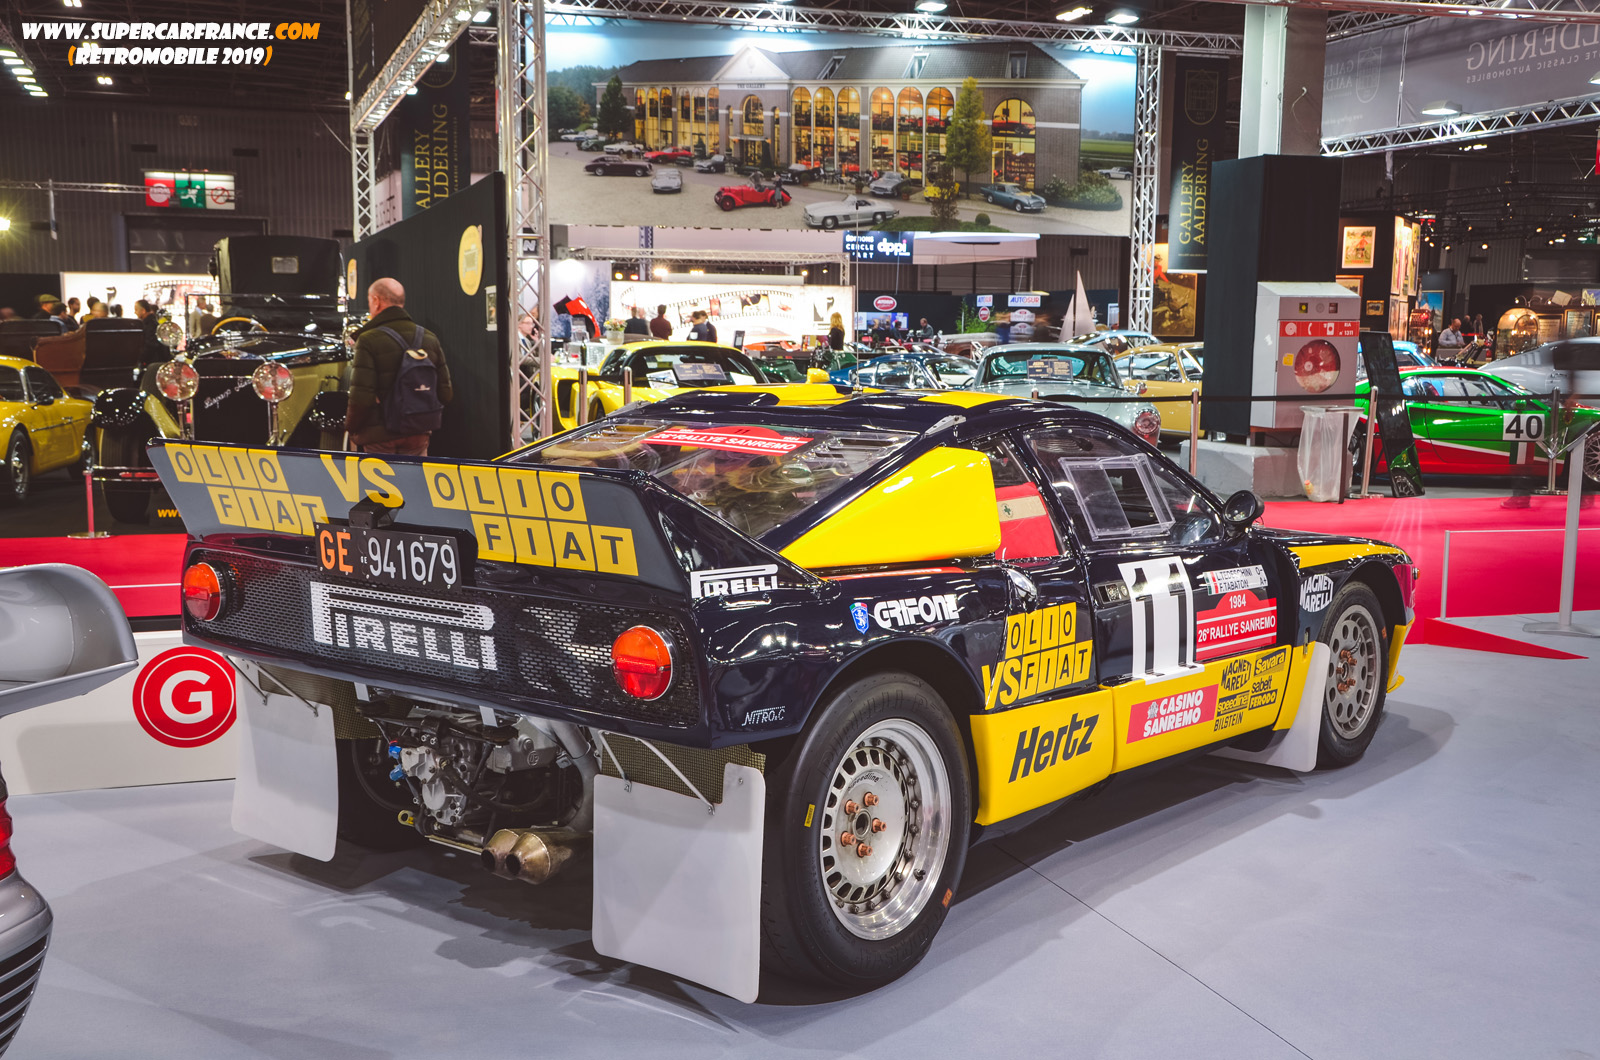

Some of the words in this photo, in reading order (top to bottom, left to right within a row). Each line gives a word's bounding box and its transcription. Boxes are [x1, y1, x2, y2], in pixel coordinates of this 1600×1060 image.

[415, 130, 431, 209] ALLERY
[433, 104, 449, 198] LDERING
[1179, 160, 1194, 245] GALLERY
[1193, 138, 1209, 245] AALDERING
[877, 238, 907, 256] dppi
[1010, 296, 1040, 304] AUTOSUR
[673, 434, 726, 444] RALLYE
[725, 437, 797, 451] SANREMO
[1505, 414, 1543, 439] 40
[175, 451, 278, 484] OLIO
[320, 453, 404, 508] VS
[219, 493, 318, 528] FIAT
[433, 472, 573, 512] OLIO
[320, 529, 354, 573] GE
[368, 537, 457, 585] 941679
[484, 523, 624, 565] FIAT
[690, 564, 779, 599] PIRELLI
[1229, 593, 1247, 609] 1984
[310, 581, 498, 671] PIRELLI
[1011, 610, 1072, 649] OLIO
[1132, 562, 1198, 677] 11
[1209, 622, 1239, 641] RALLYE
[1240, 615, 1276, 634] SANREMO
[1025, 648, 1087, 690] FIAT
[159, 669, 213, 724] G
[1159, 690, 1204, 716] CASINO
[1249, 691, 1277, 709] FERODO
[1143, 707, 1201, 738] SANREMO
[1214, 711, 1244, 732] BILSTEIN
[1008, 713, 1100, 784] Hertz
